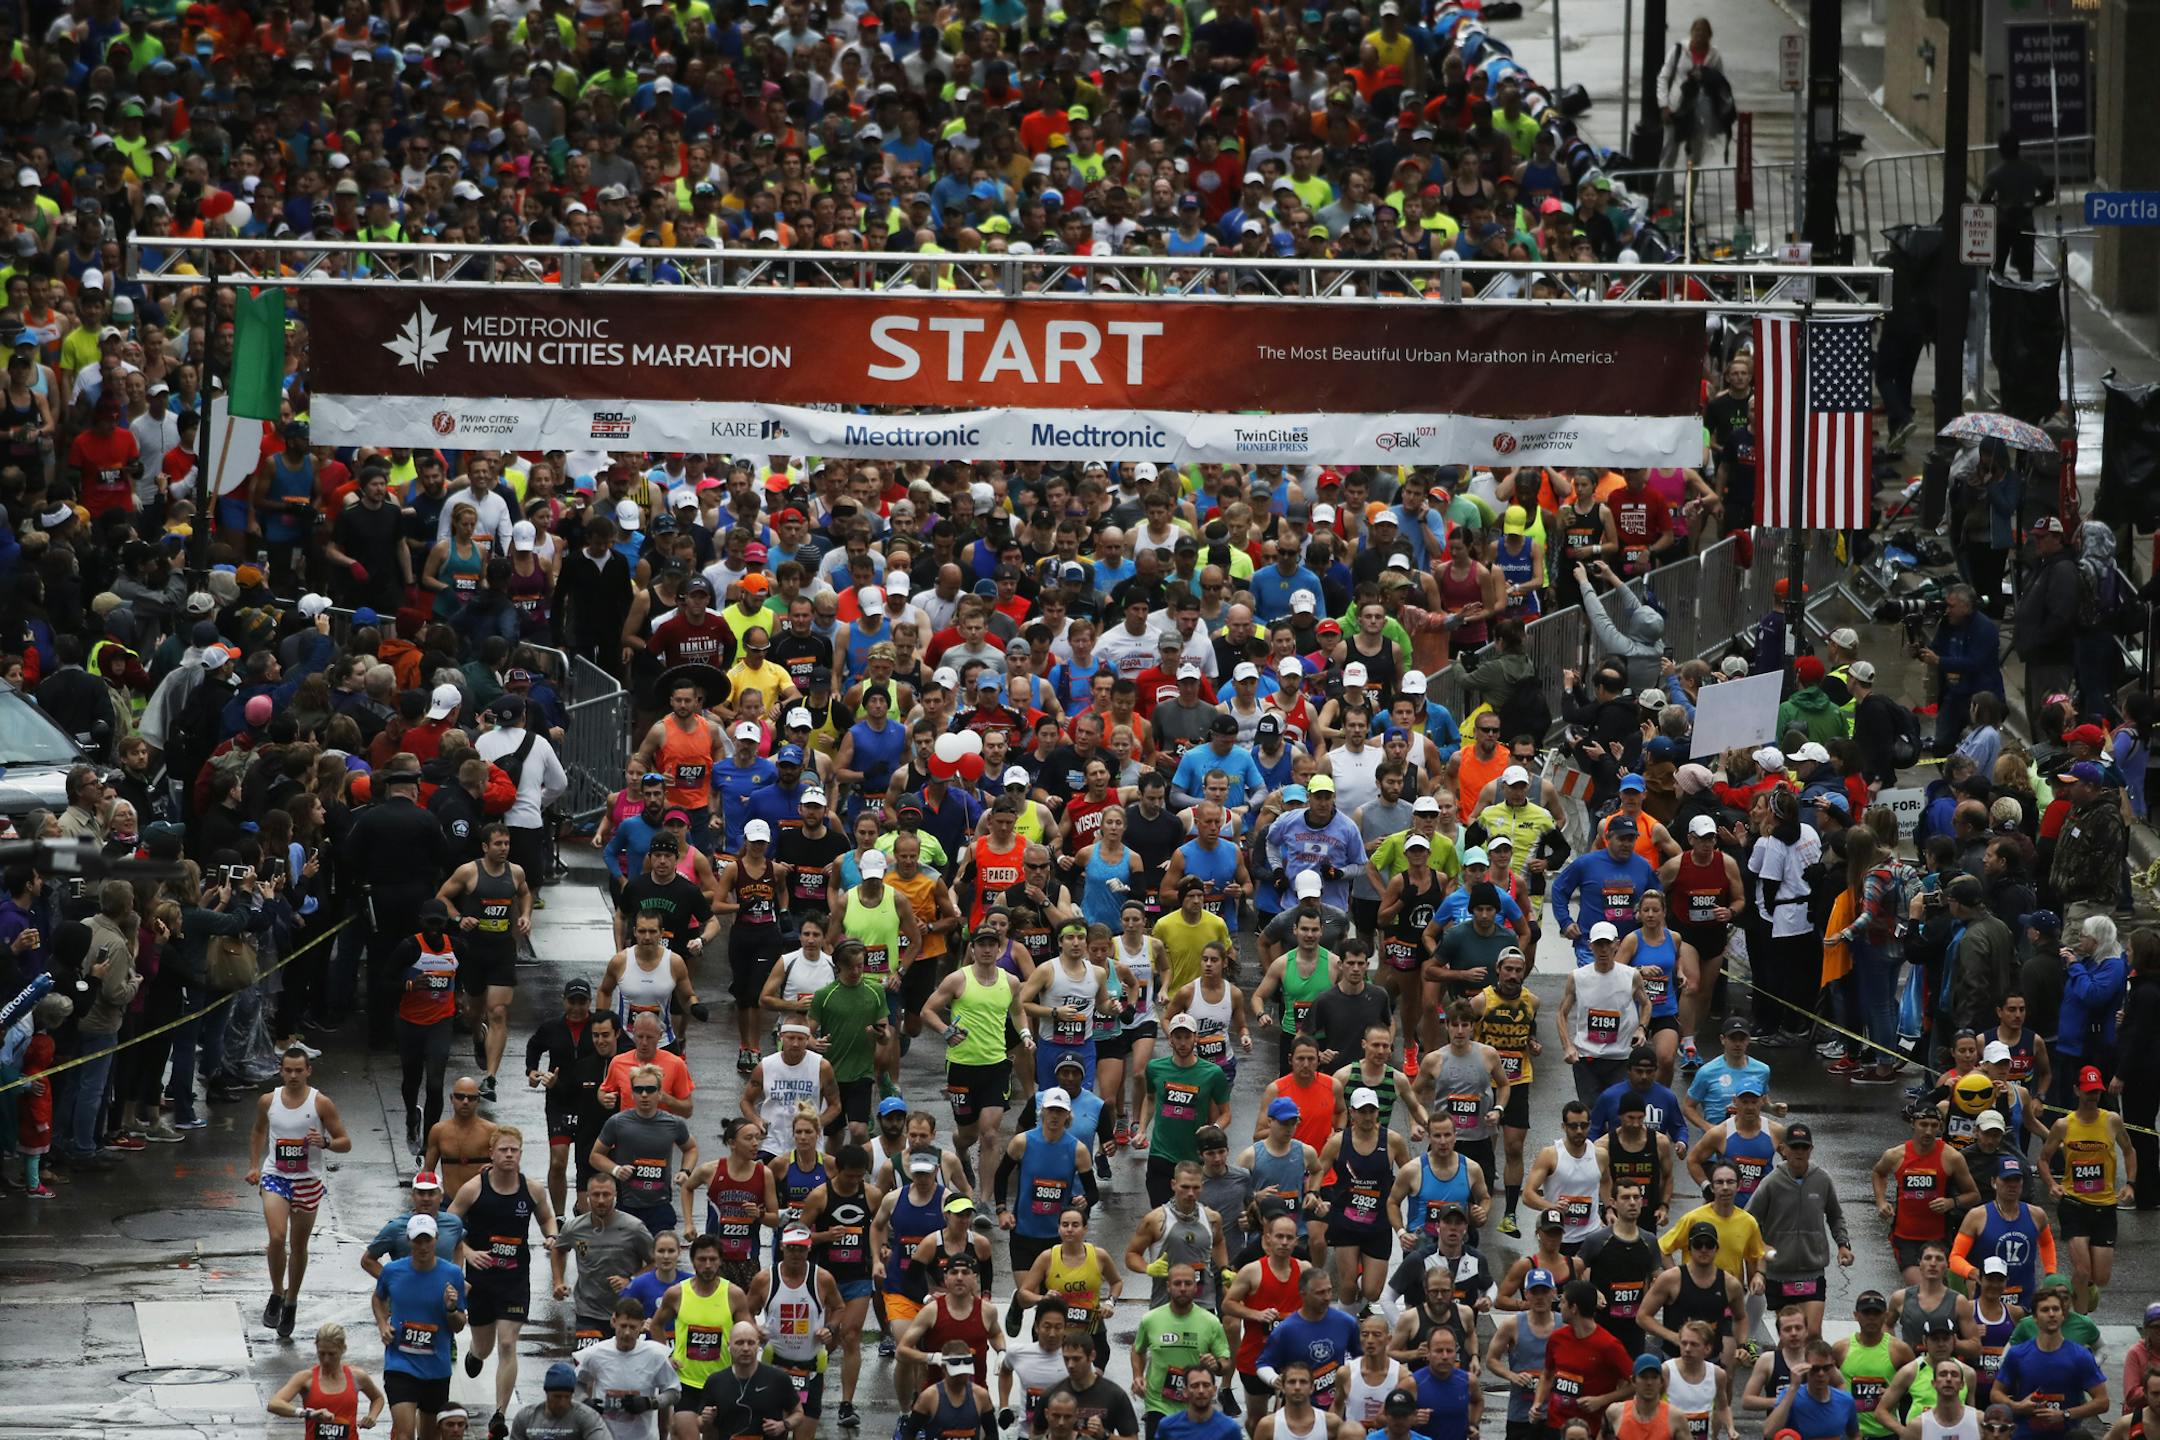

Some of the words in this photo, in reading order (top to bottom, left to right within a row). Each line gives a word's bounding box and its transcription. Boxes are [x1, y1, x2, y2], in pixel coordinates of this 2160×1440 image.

[2022, 35, 2071, 48] EVENT
[2014, 52, 2080, 63] PARKING
[2015, 73, 2027, 89] $
[2032, 73, 2080, 88] 3000
[2031, 112, 2063, 123] ONY
[1973, 209, 1984, 219] NO
[2092, 198, 2159, 219] Portla
[1964, 219, 1993, 229] PARKING
[1968, 230, 1988, 239] DRIVE
[1971, 239, 1986, 247] WAY
[1788, 248, 1800, 258] NO
[463, 316, 609, 339] MEDTRONIC
[463, 340, 532, 364] TWIN
[538, 343, 625, 366] CITIES
[632, 343, 791, 368] MARATHON
[867, 315, 1164, 385] START
[1257, 346, 1286, 360] The
[1290, 346, 1328, 361] Most
[1332, 347, 1401, 362] Beautiful
[1405, 348, 1452, 363] Urban
[1456, 349, 1527, 363] Marathon
[1532, 350, 1545, 363] in
[460, 415, 486, 424] TWIN
[488, 415, 519, 424] CITIES
[593, 412, 623, 422] 1500
[460, 424, 470, 434] IN
[472, 425, 514, 434] MOTION
[711, 421, 758, 437] KARE
[845, 424, 980, 446] Medtronic
[1416, 427, 1436, 437] 107.1
[1031, 423, 1166, 448] Medtronic
[1234, 429, 1308, 442] TwinCities
[1522, 433, 1546, 441] TWIN
[1548, 432, 1579, 441] CITIES
[1236, 442, 1278, 452] PIONEER
[1279, 442, 1308, 452] PRESS
[1520, 442, 1531, 450] IN
[1532, 441, 1573, 450] MOTION
[1567, 535, 1589, 545] 2514
[679, 640, 718, 653] HAMLINE
[791, 663, 813, 674] 2955
[679, 765, 704, 777] 2247
[1892, 800, 1921, 811] FOR:
[799, 874, 824, 885] 2283
[740, 883, 774, 895] GOLDEN
[639, 897, 678, 913] MINNESOTA
[1606, 894, 1630, 906] 1962
[1692, 896, 1716, 907] 3602
[1024, 934, 1048, 946] 1480
[867, 950, 886, 962] 282
[1057, 1022, 1083, 1034] 2410
[1591, 1016, 1616, 1029] 2194
[1485, 1035, 1528, 1047] PROJECT
[770, 1079, 813, 1092] JUNIOR
[1167, 1090, 1193, 1104] 2357
[1451, 1100, 1477, 1113] 1260
[636, 1165, 662, 1179] 2893
[2075, 1165, 2102, 1179] 2444
[1906, 1175, 1933, 1188] 2530
[1035, 1186, 1062, 1199] 3958
[1351, 1194, 1377, 1209] 2932
[1566, 1203, 1589, 1215] 455
[723, 1224, 749, 1237] 2225
[833, 1234, 859, 1246] 120
[1064, 1280, 1087, 1292] GCR
[1614, 1289, 1640, 1302] 2617
[1067, 1308, 1088, 1320] 839
[405, 1329, 432, 1344] 3132
[691, 1331, 718, 1345] 2238
[1556, 1378, 1579, 1394] 2015
[318, 1424, 345, 1437] 3501
